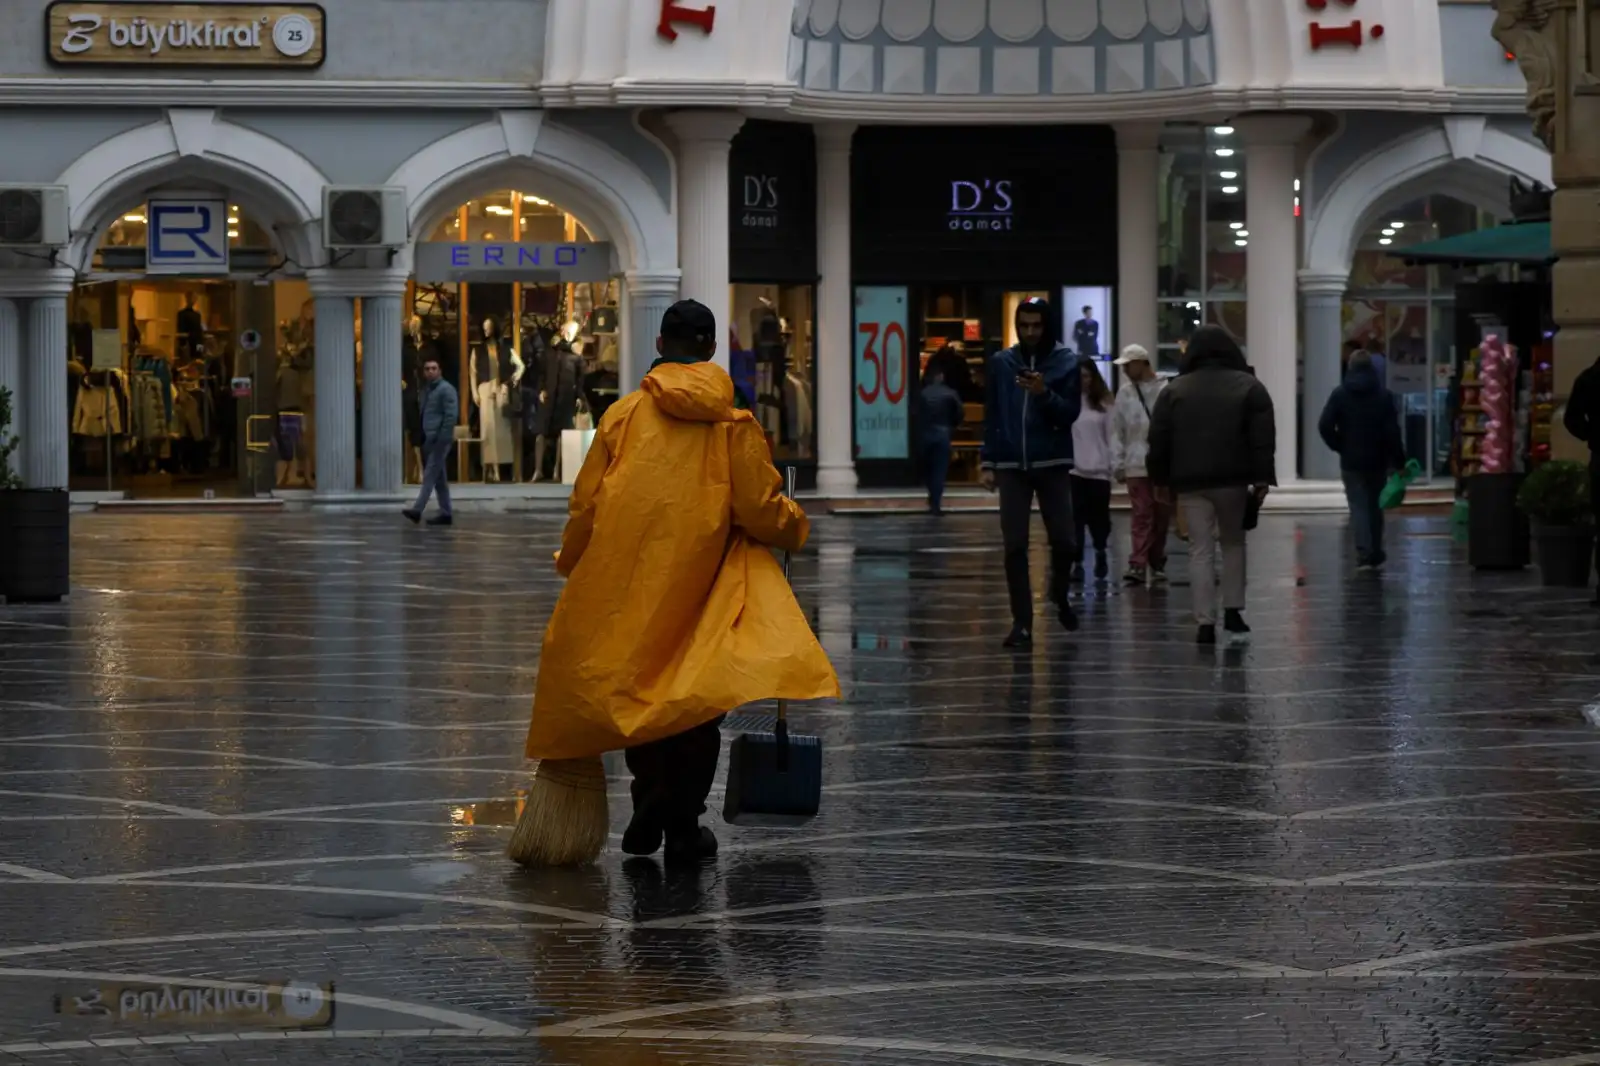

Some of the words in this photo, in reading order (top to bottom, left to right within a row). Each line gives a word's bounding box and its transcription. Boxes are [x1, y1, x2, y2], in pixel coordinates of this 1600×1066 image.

[287, 30, 303, 41] 25
[744, 174, 778, 208] D'S
[951, 178, 1012, 211] D'S
[153, 206, 222, 258] ER
[948, 217, 1012, 230] damat
[452, 246, 577, 266] ERNO
[858, 322, 906, 404] 30
